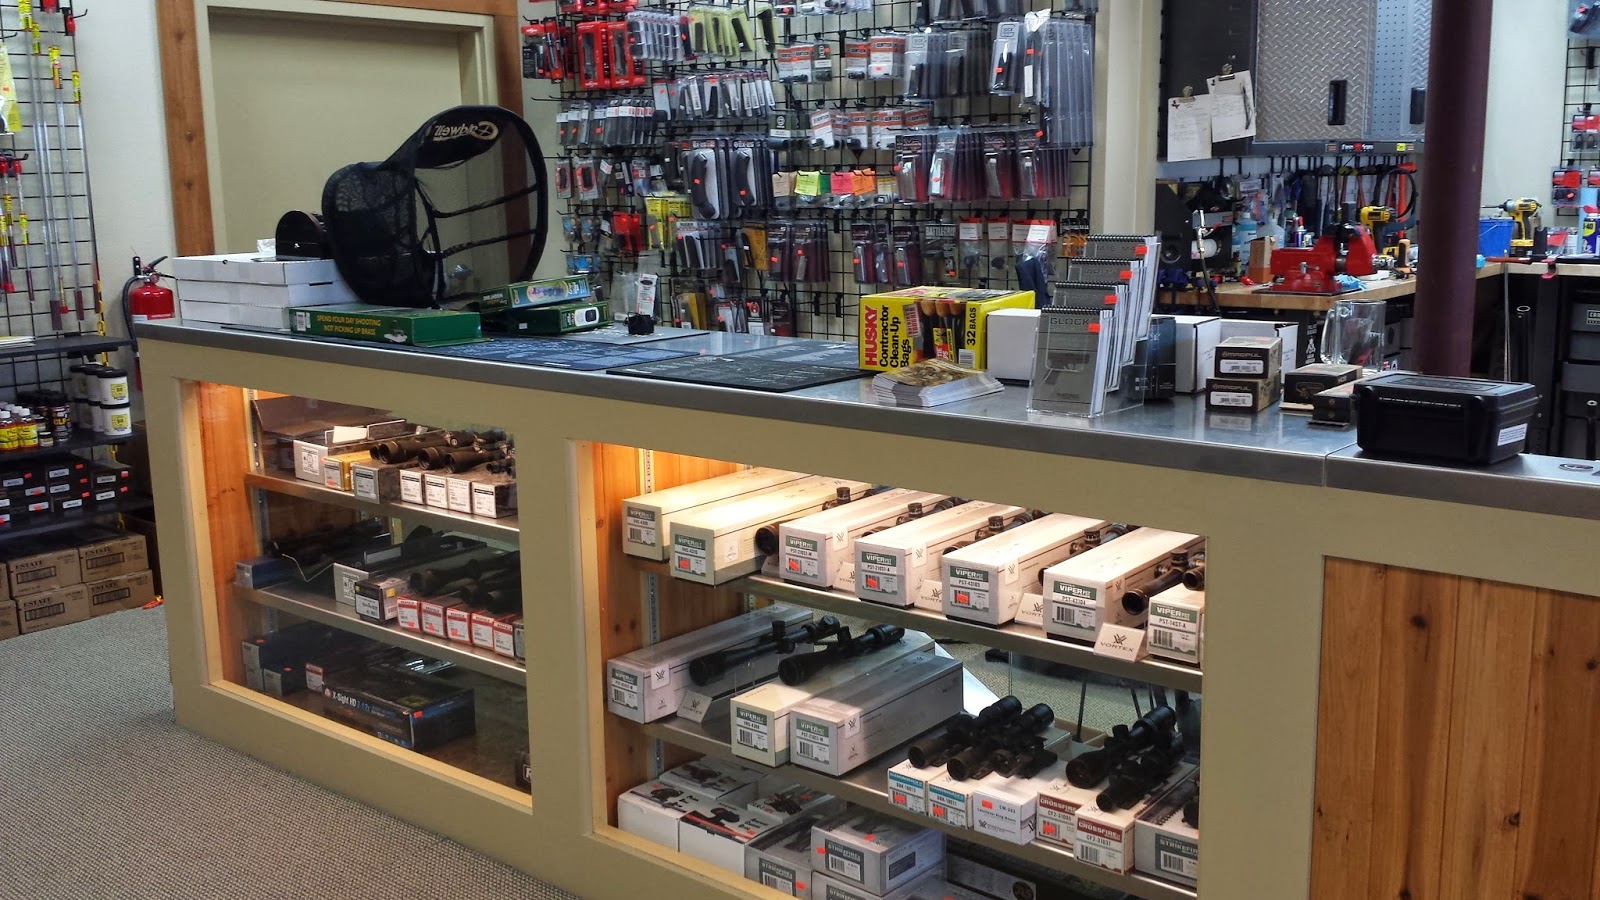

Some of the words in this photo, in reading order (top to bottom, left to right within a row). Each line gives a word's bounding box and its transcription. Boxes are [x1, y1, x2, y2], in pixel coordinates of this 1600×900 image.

[355, 318, 381, 326] SHOOTING
[1050, 318, 1090, 326] GLOCK
[864, 305, 878, 366] HUSKY
[880, 305, 889, 367] Contractor
[966, 330, 976, 346] 32
[900, 338, 912, 368] Bags
[678, 537, 694, 546] VIPER
[790, 540, 806, 548] VIPER
[866, 554, 885, 564] VIPER
[16, 560, 42, 570] ESTATE
[956, 569, 976, 577] VIPER
[91, 583, 117, 592] ESTATE
[1059, 585, 1083, 594] VIPER
[24, 597, 52, 607] ESTATE
[1157, 606, 1182, 616] VIPER
[1100, 642, 1134, 652] VORTEX
[350, 696, 356, 707] HD
[740, 711, 756, 720] VIPER
[800, 722, 818, 732] VIPER
[1040, 799, 1076, 812] CROSSFIRE
[1078, 822, 1116, 837] CROSSFIRE
